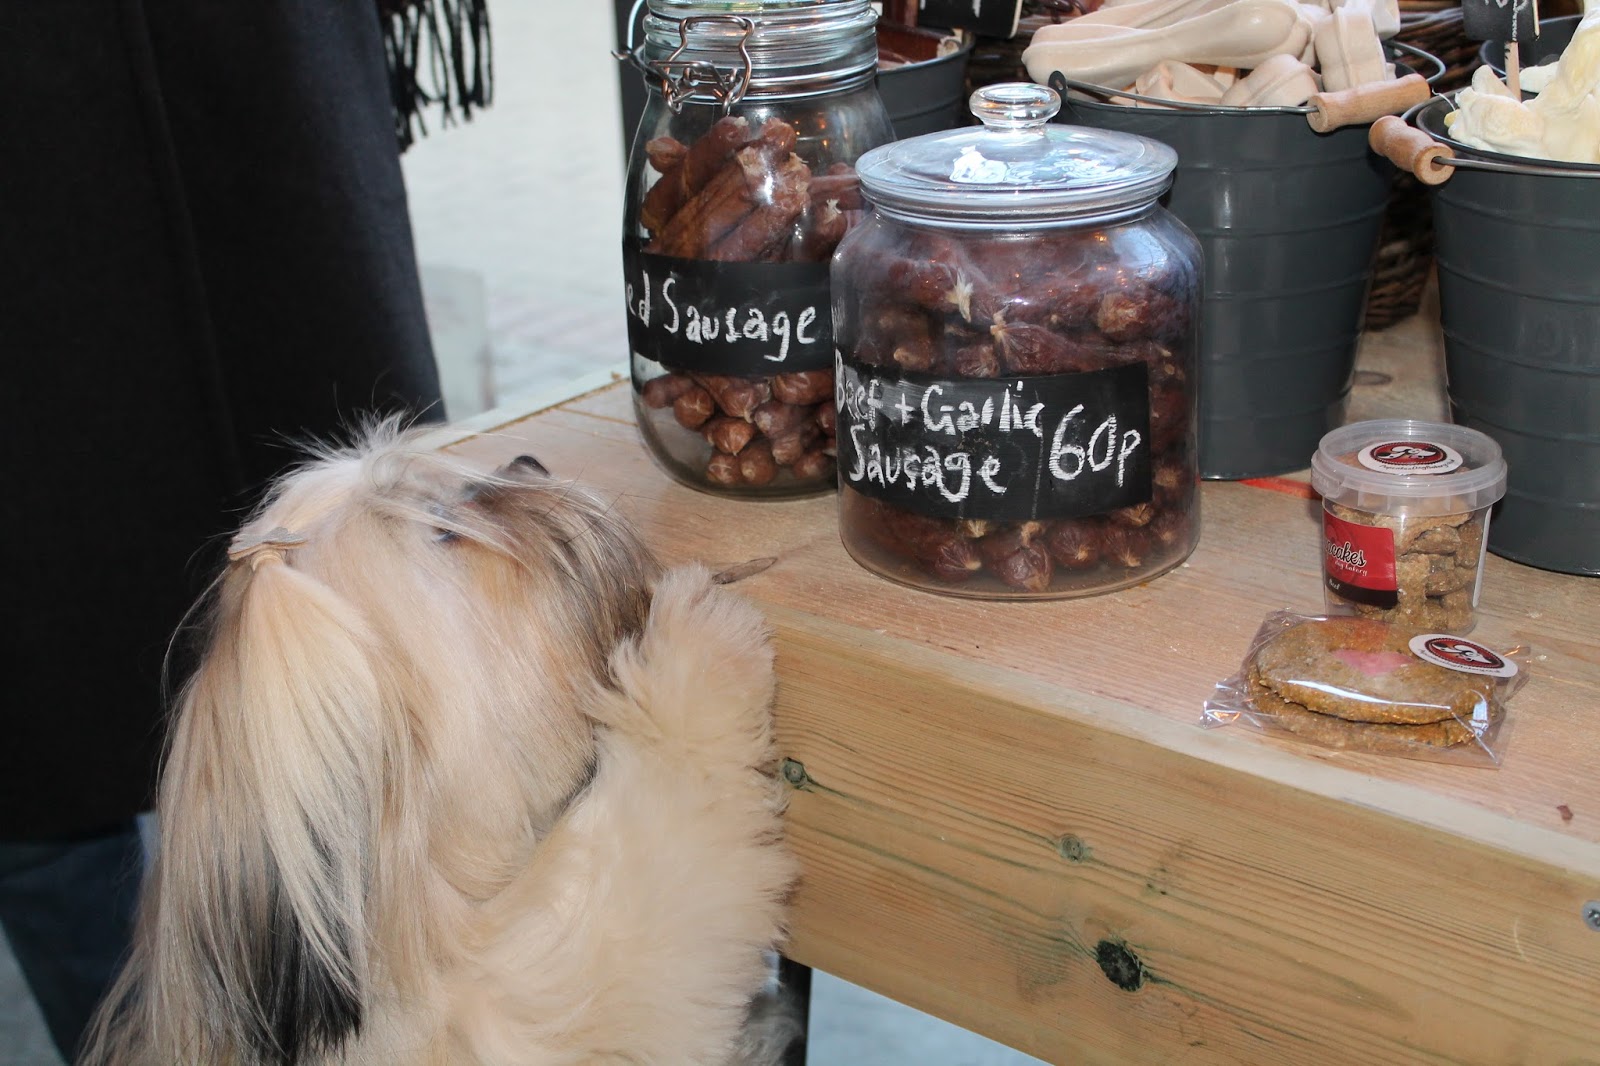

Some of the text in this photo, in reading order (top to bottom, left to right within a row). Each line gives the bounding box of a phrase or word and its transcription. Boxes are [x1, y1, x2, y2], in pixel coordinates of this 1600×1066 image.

[662, 277, 816, 362] Sausage
[895, 392, 915, 427] +
[920, 380, 1045, 438] Garlic
[1049, 403, 1141, 487] 60p
[849, 424, 1007, 502] Sausage
